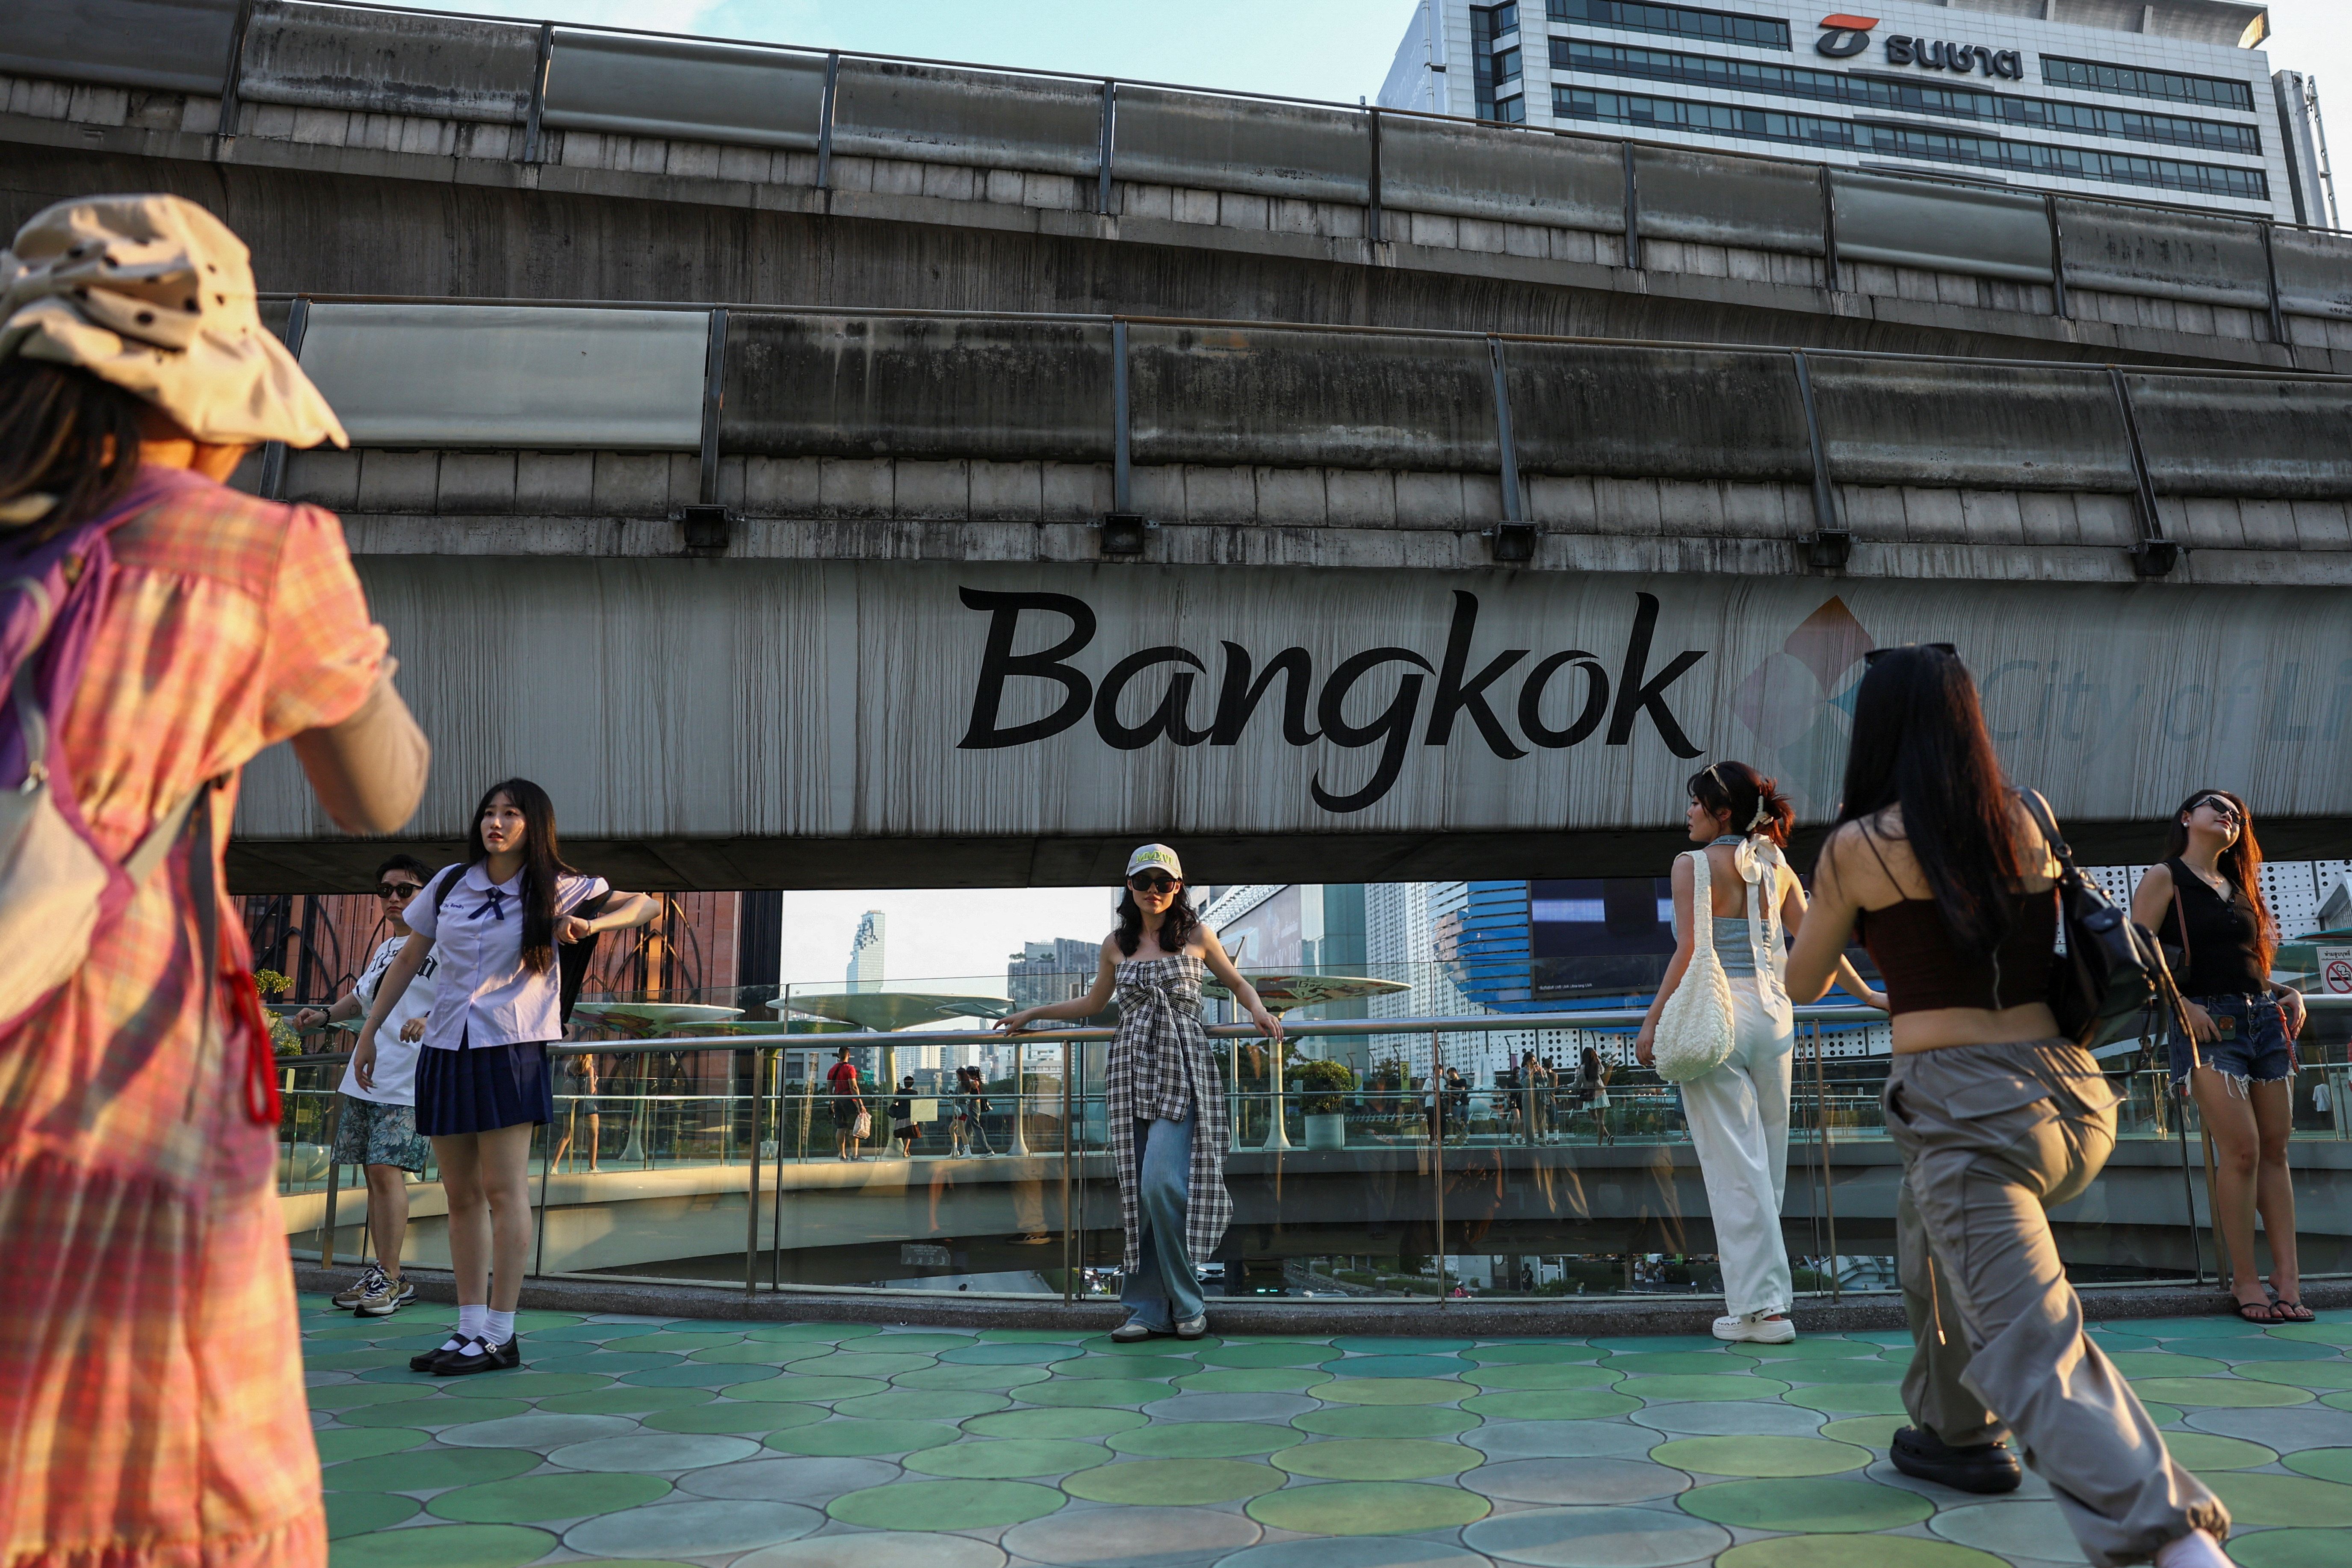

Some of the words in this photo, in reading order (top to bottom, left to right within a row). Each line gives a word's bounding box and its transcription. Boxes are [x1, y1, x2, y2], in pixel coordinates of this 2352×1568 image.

[1886, 34, 2024, 80] ธนชาต
[956, 585, 1708, 812] Bangkok
[1980, 659, 2144, 765] City
[2163, 659, 2263, 742] of
